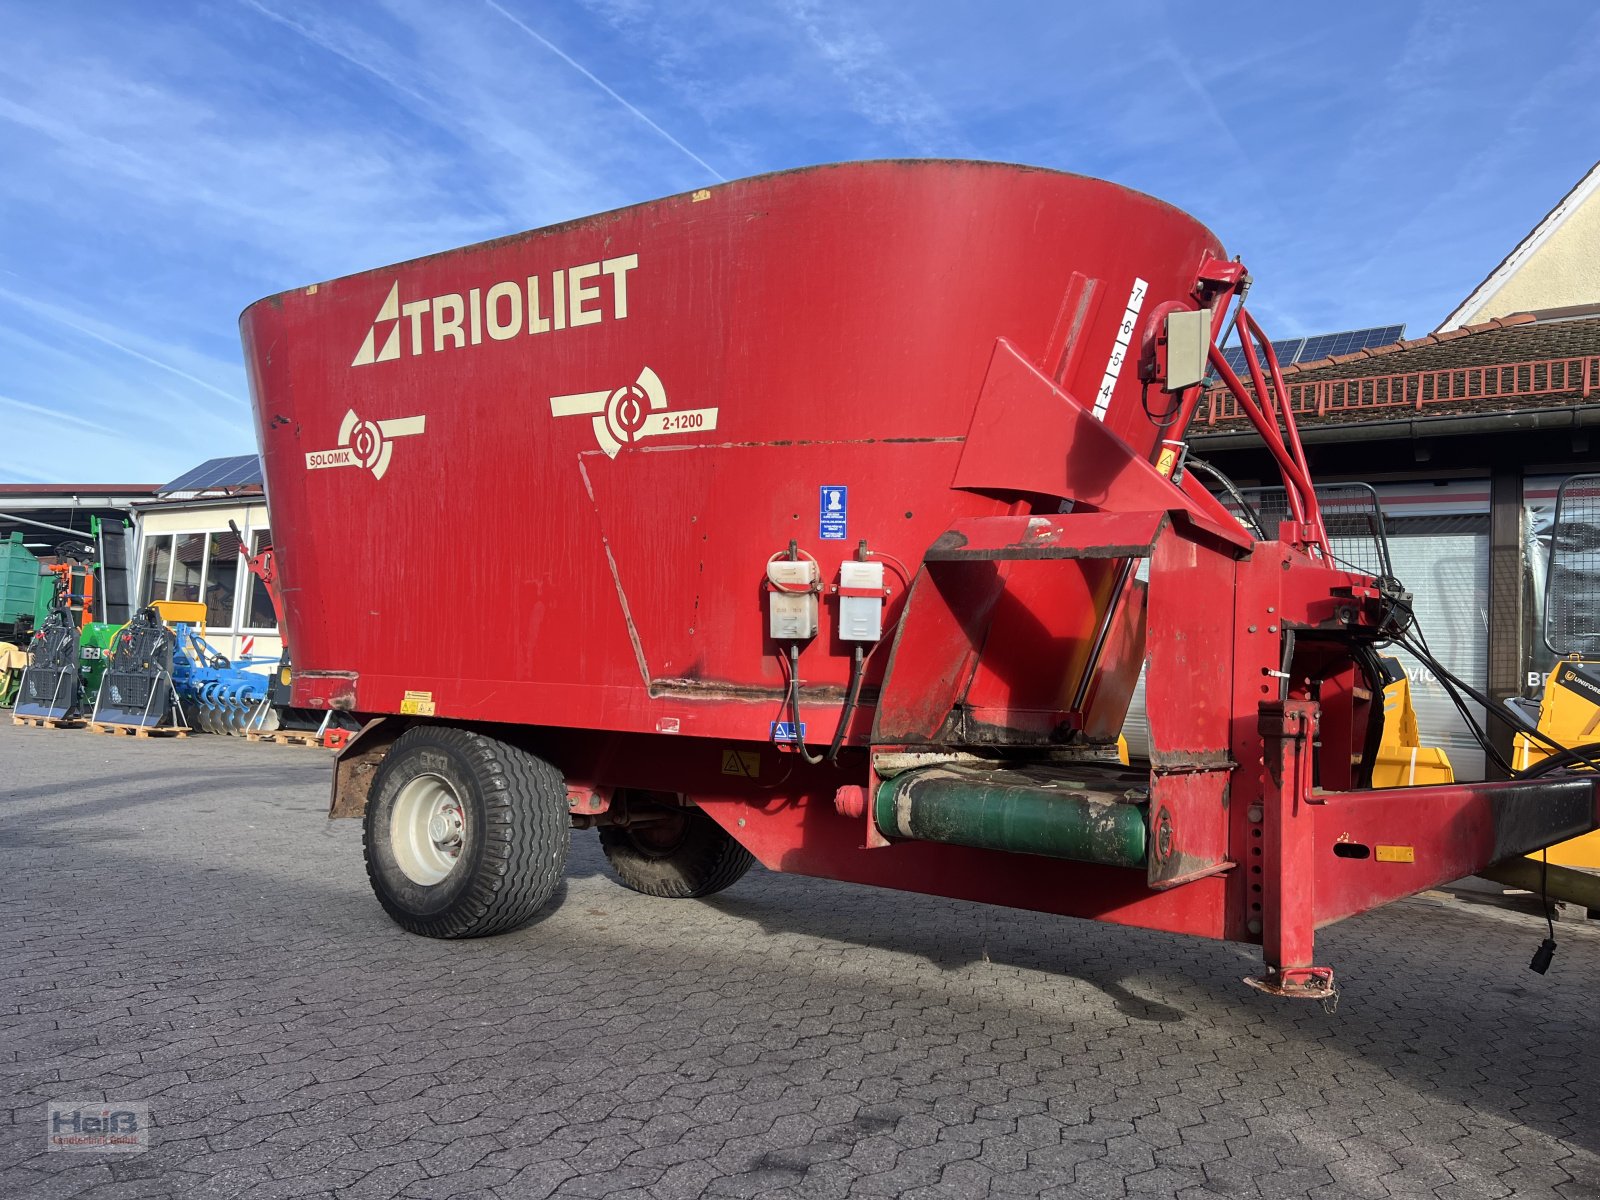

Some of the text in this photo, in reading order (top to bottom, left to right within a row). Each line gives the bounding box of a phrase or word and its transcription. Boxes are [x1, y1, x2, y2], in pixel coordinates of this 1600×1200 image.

[1134, 288, 1143, 302] 7
[402, 253, 639, 356] TRIOLIET
[1123, 320, 1132, 335] 6
[1112, 352, 1122, 367] 5
[1102, 385, 1111, 399] 4
[662, 414, 703, 430] 2-1200
[310, 452, 350, 466] SOLOMIX
